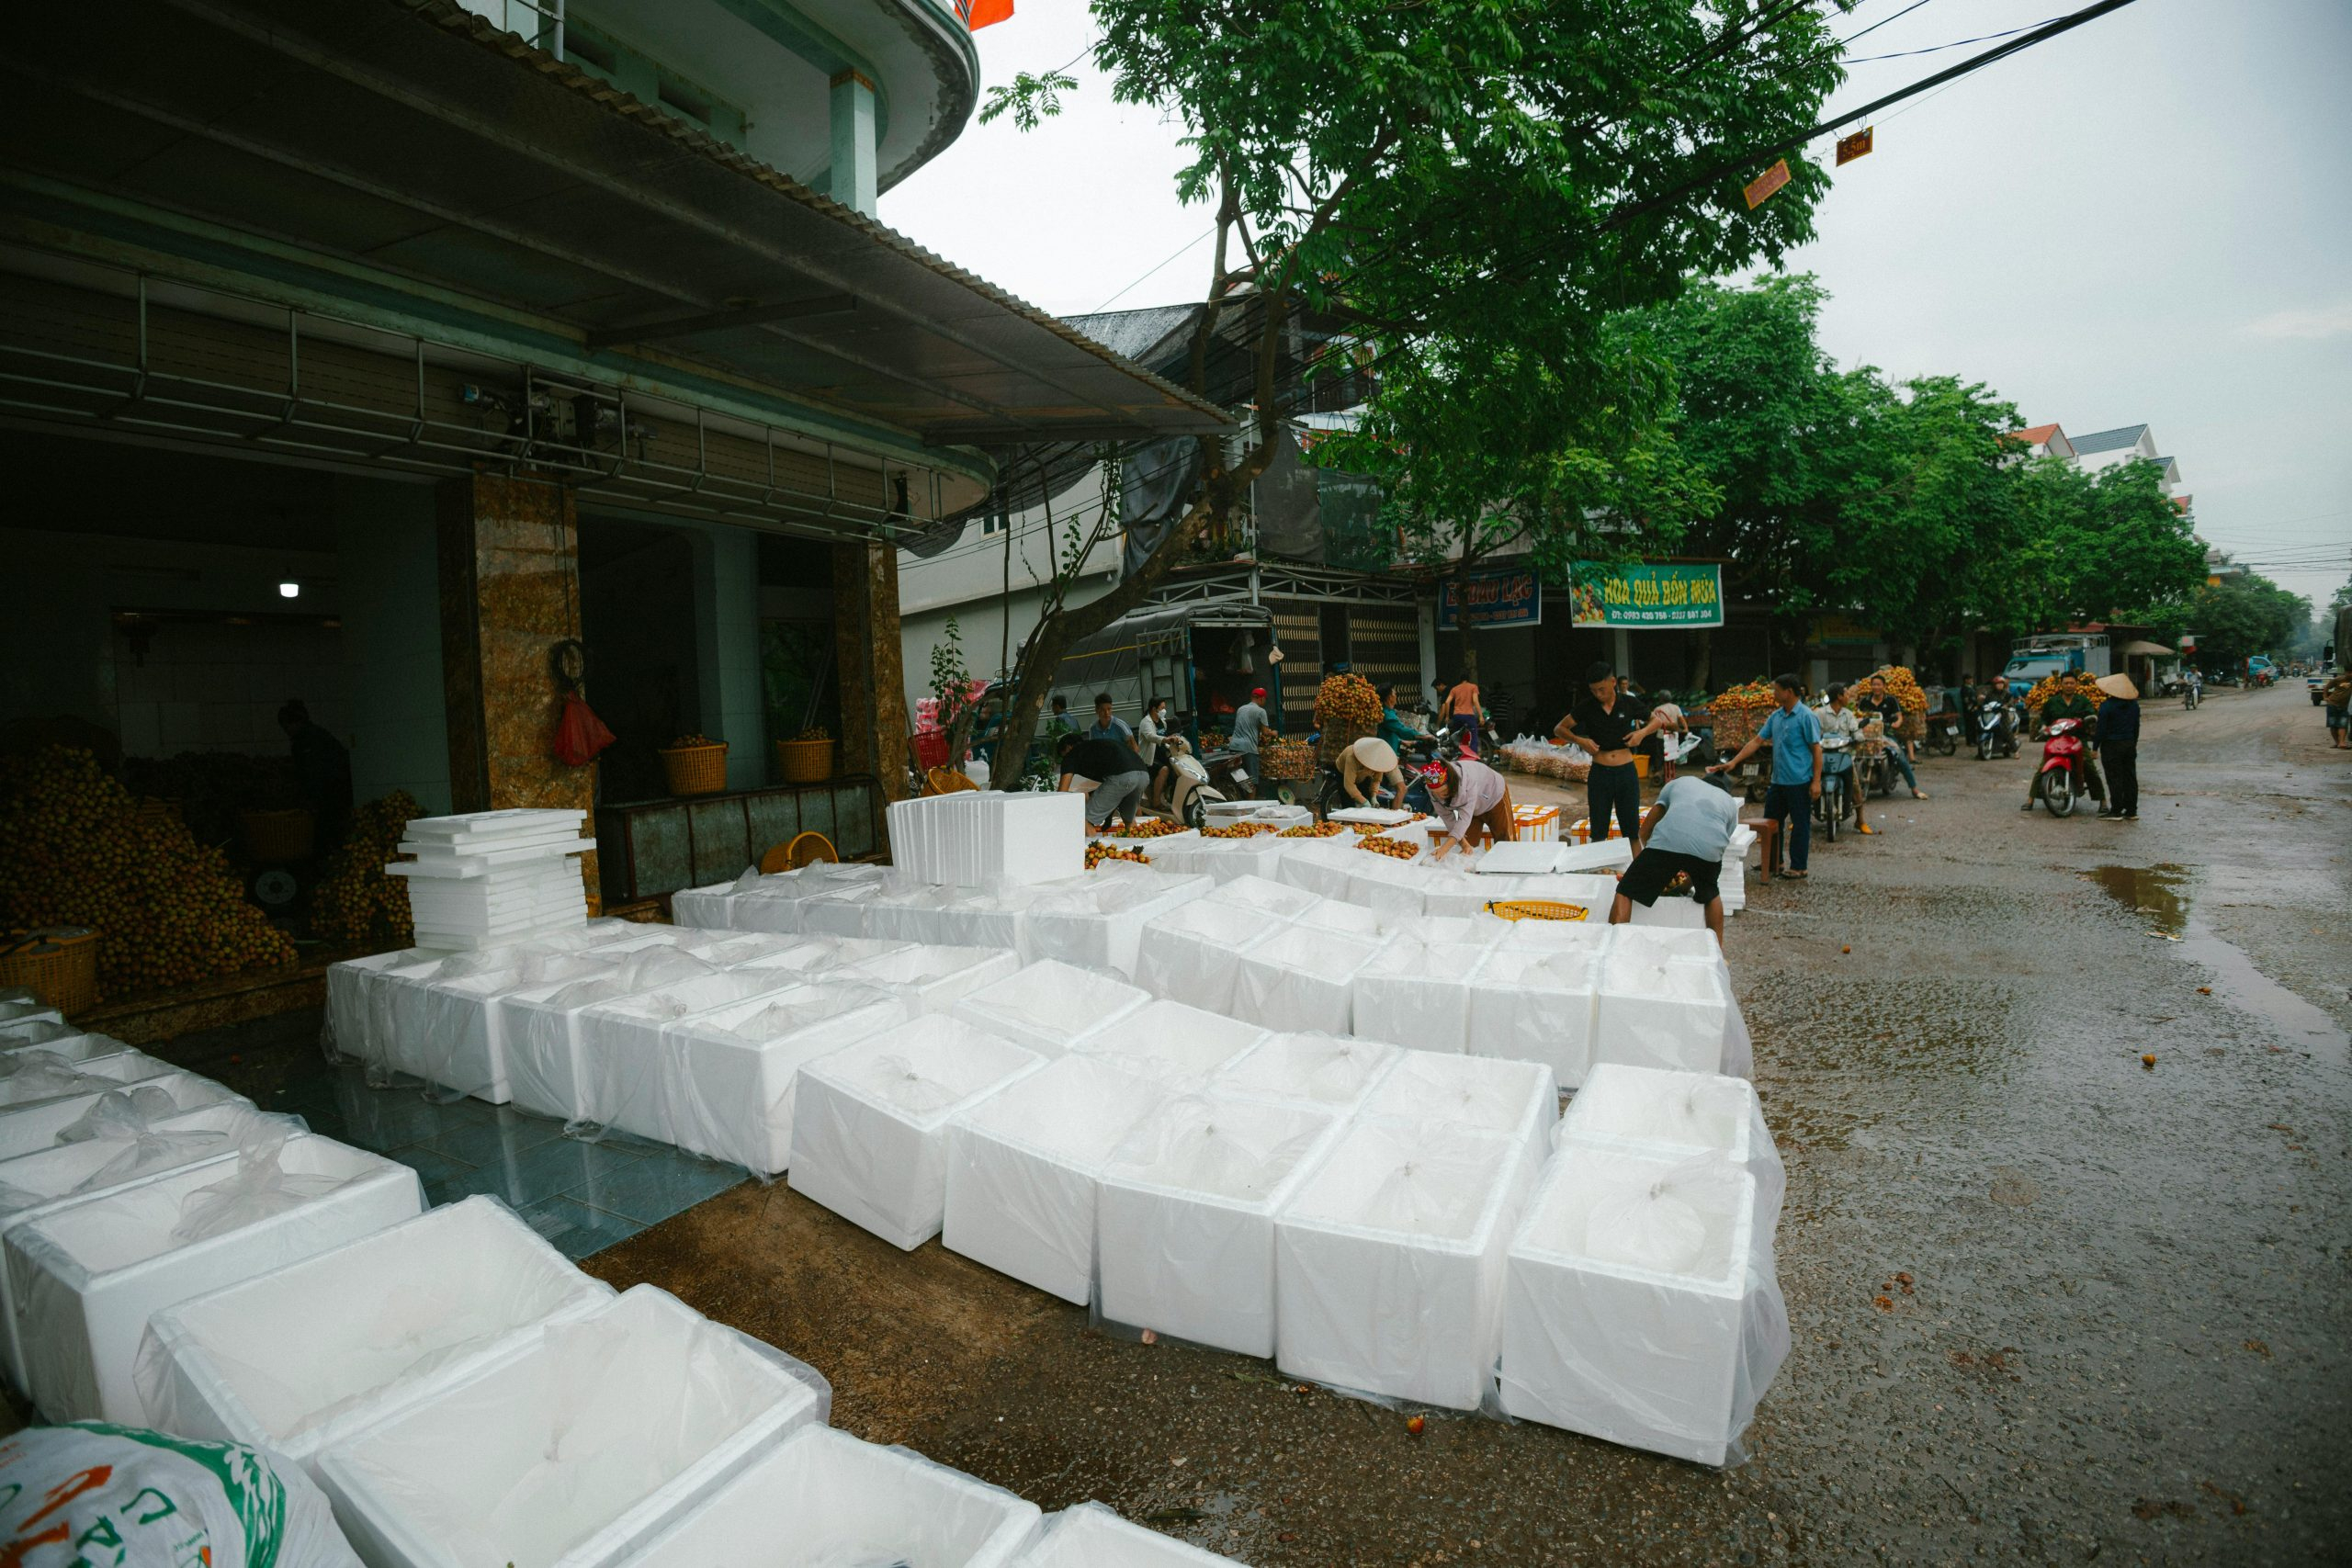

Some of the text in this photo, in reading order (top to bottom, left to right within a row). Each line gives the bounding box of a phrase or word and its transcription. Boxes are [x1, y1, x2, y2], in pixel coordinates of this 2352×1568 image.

[1502, 574, 1532, 606] LẠC
[1604, 578, 1631, 604] HOA
[1634, 571, 1659, 608] QUẢ
[1662, 570, 1688, 605] BỐN
